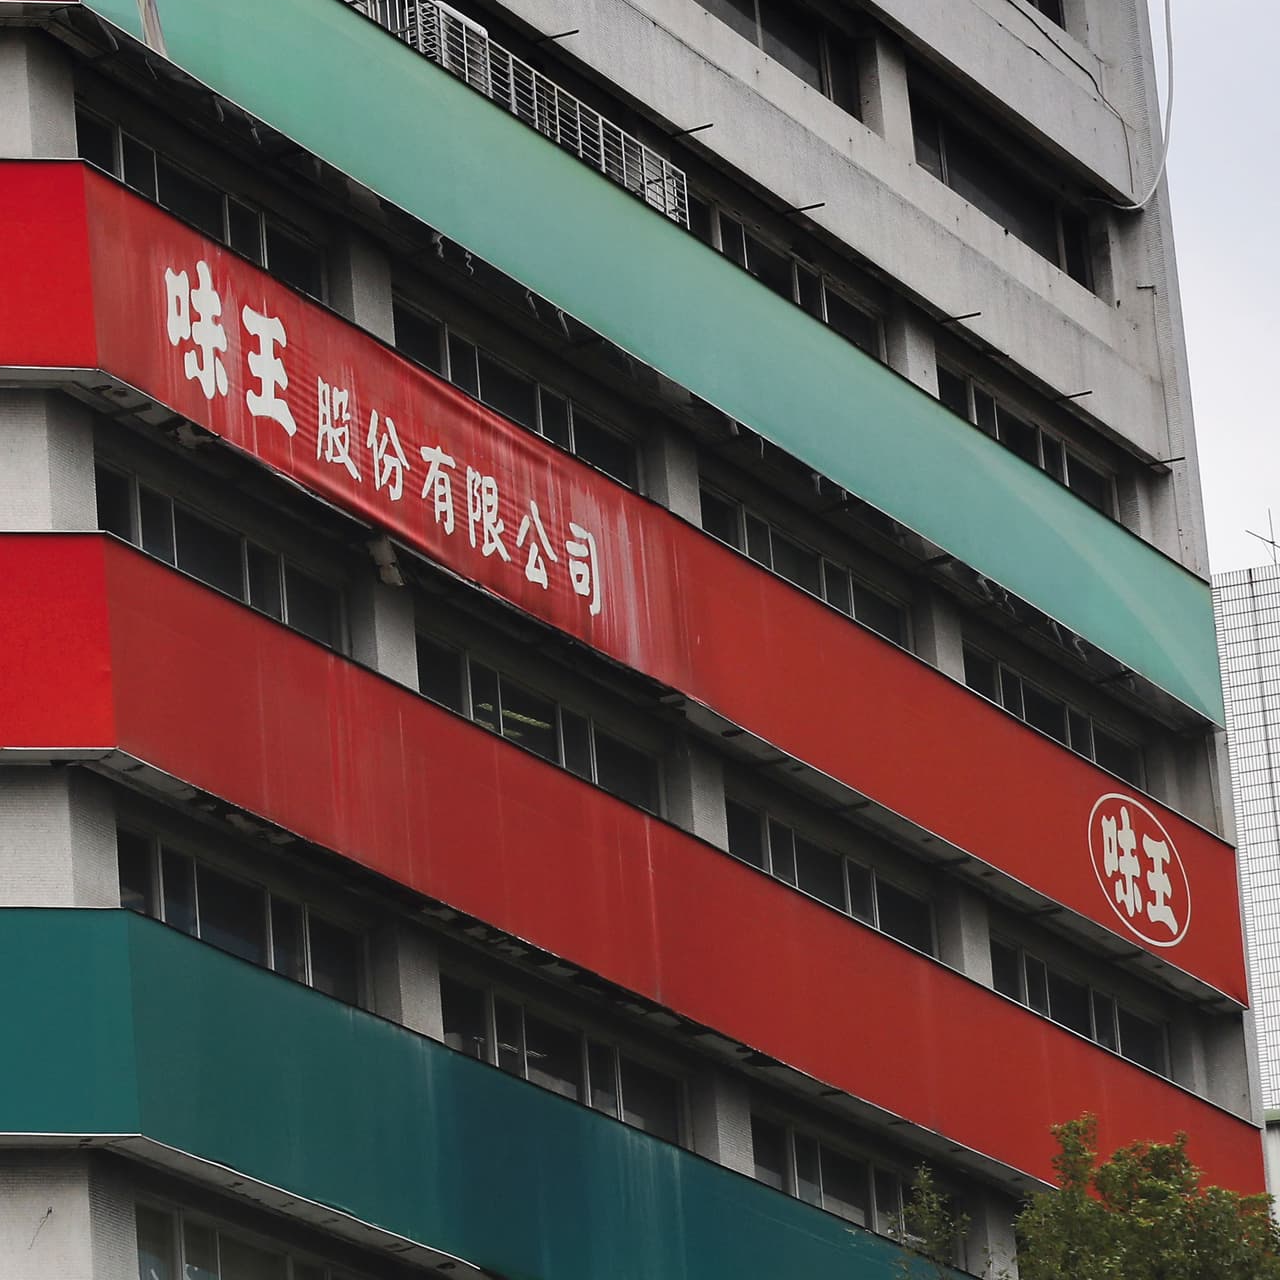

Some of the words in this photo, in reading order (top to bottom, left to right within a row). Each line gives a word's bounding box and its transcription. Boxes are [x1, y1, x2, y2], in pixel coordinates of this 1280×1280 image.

[163, 260, 605, 617] 味王股份有限公司
[1101, 806, 1179, 935] 味王
